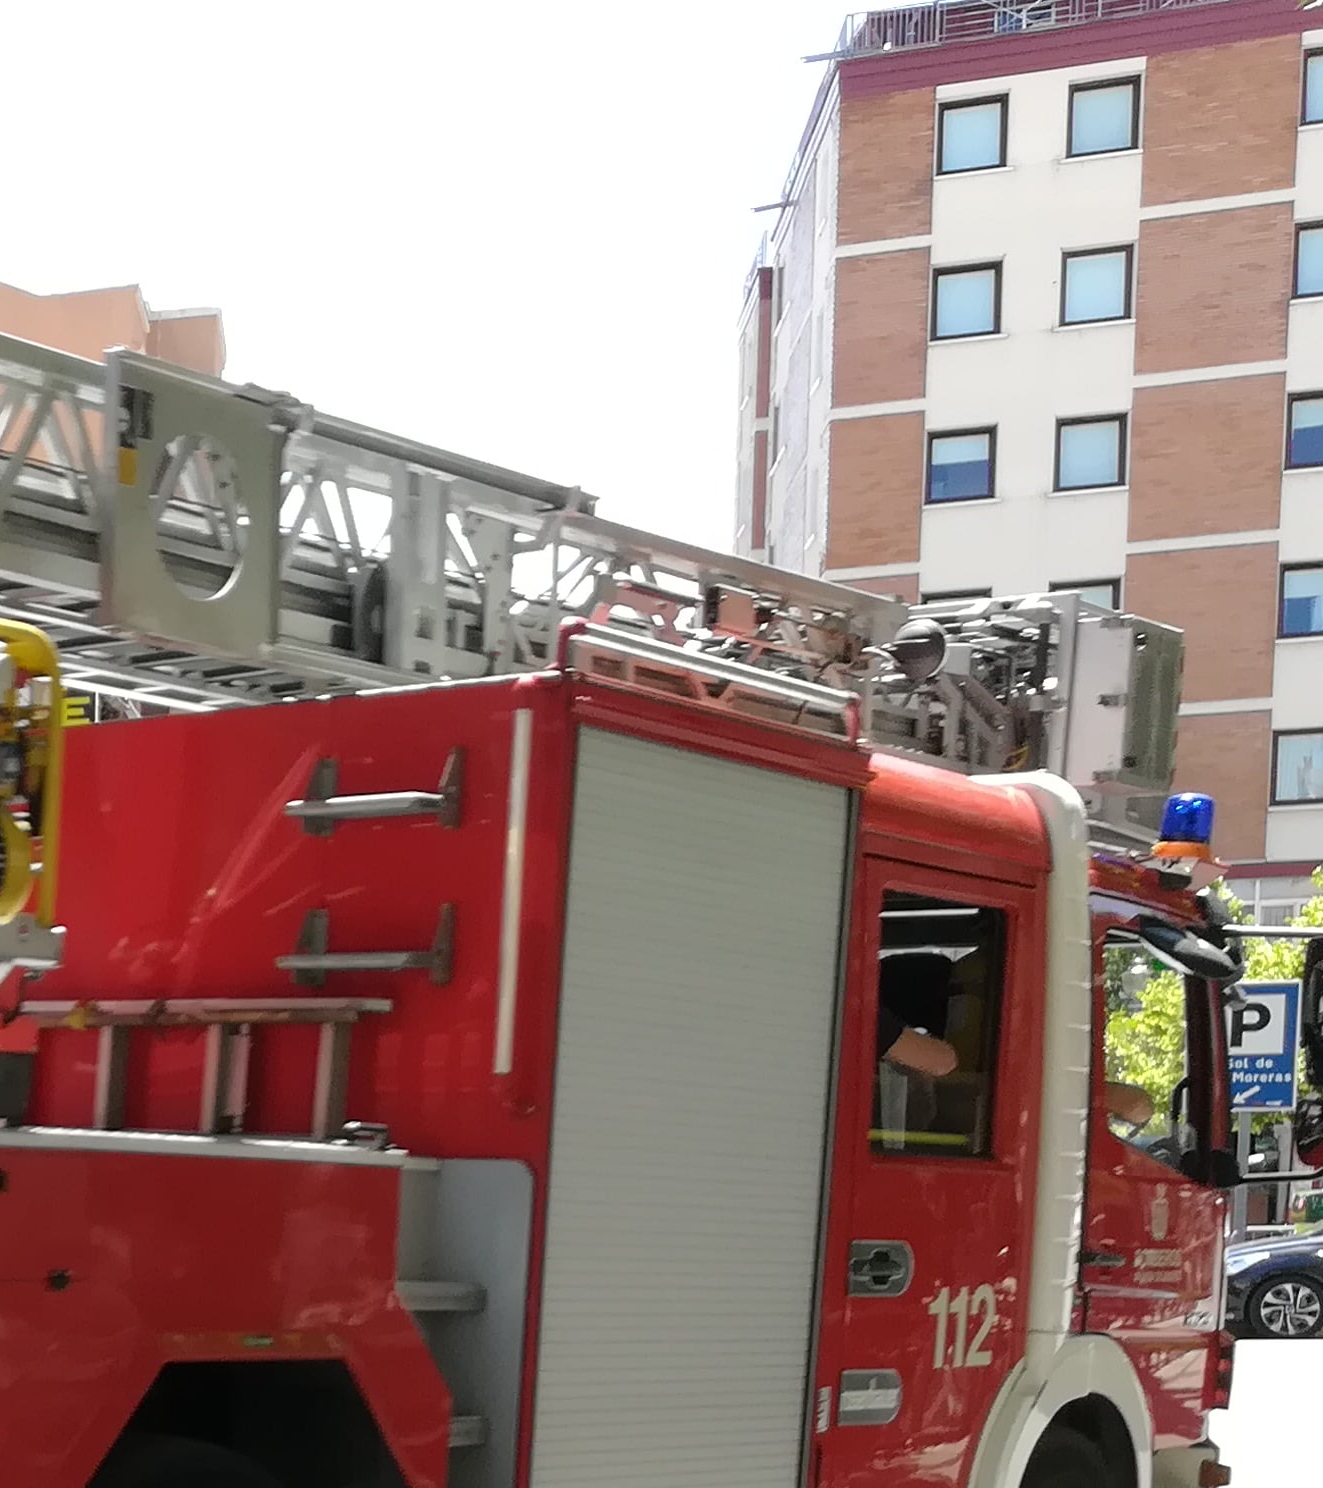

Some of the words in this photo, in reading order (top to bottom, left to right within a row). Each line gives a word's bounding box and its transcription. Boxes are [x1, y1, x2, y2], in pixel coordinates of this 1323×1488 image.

[1230, 1002, 1271, 1048] P
[1232, 1072, 1292, 1083] Moreras
[1255, 1057, 1274, 1069] de
[927, 1283, 997, 1370] 112
